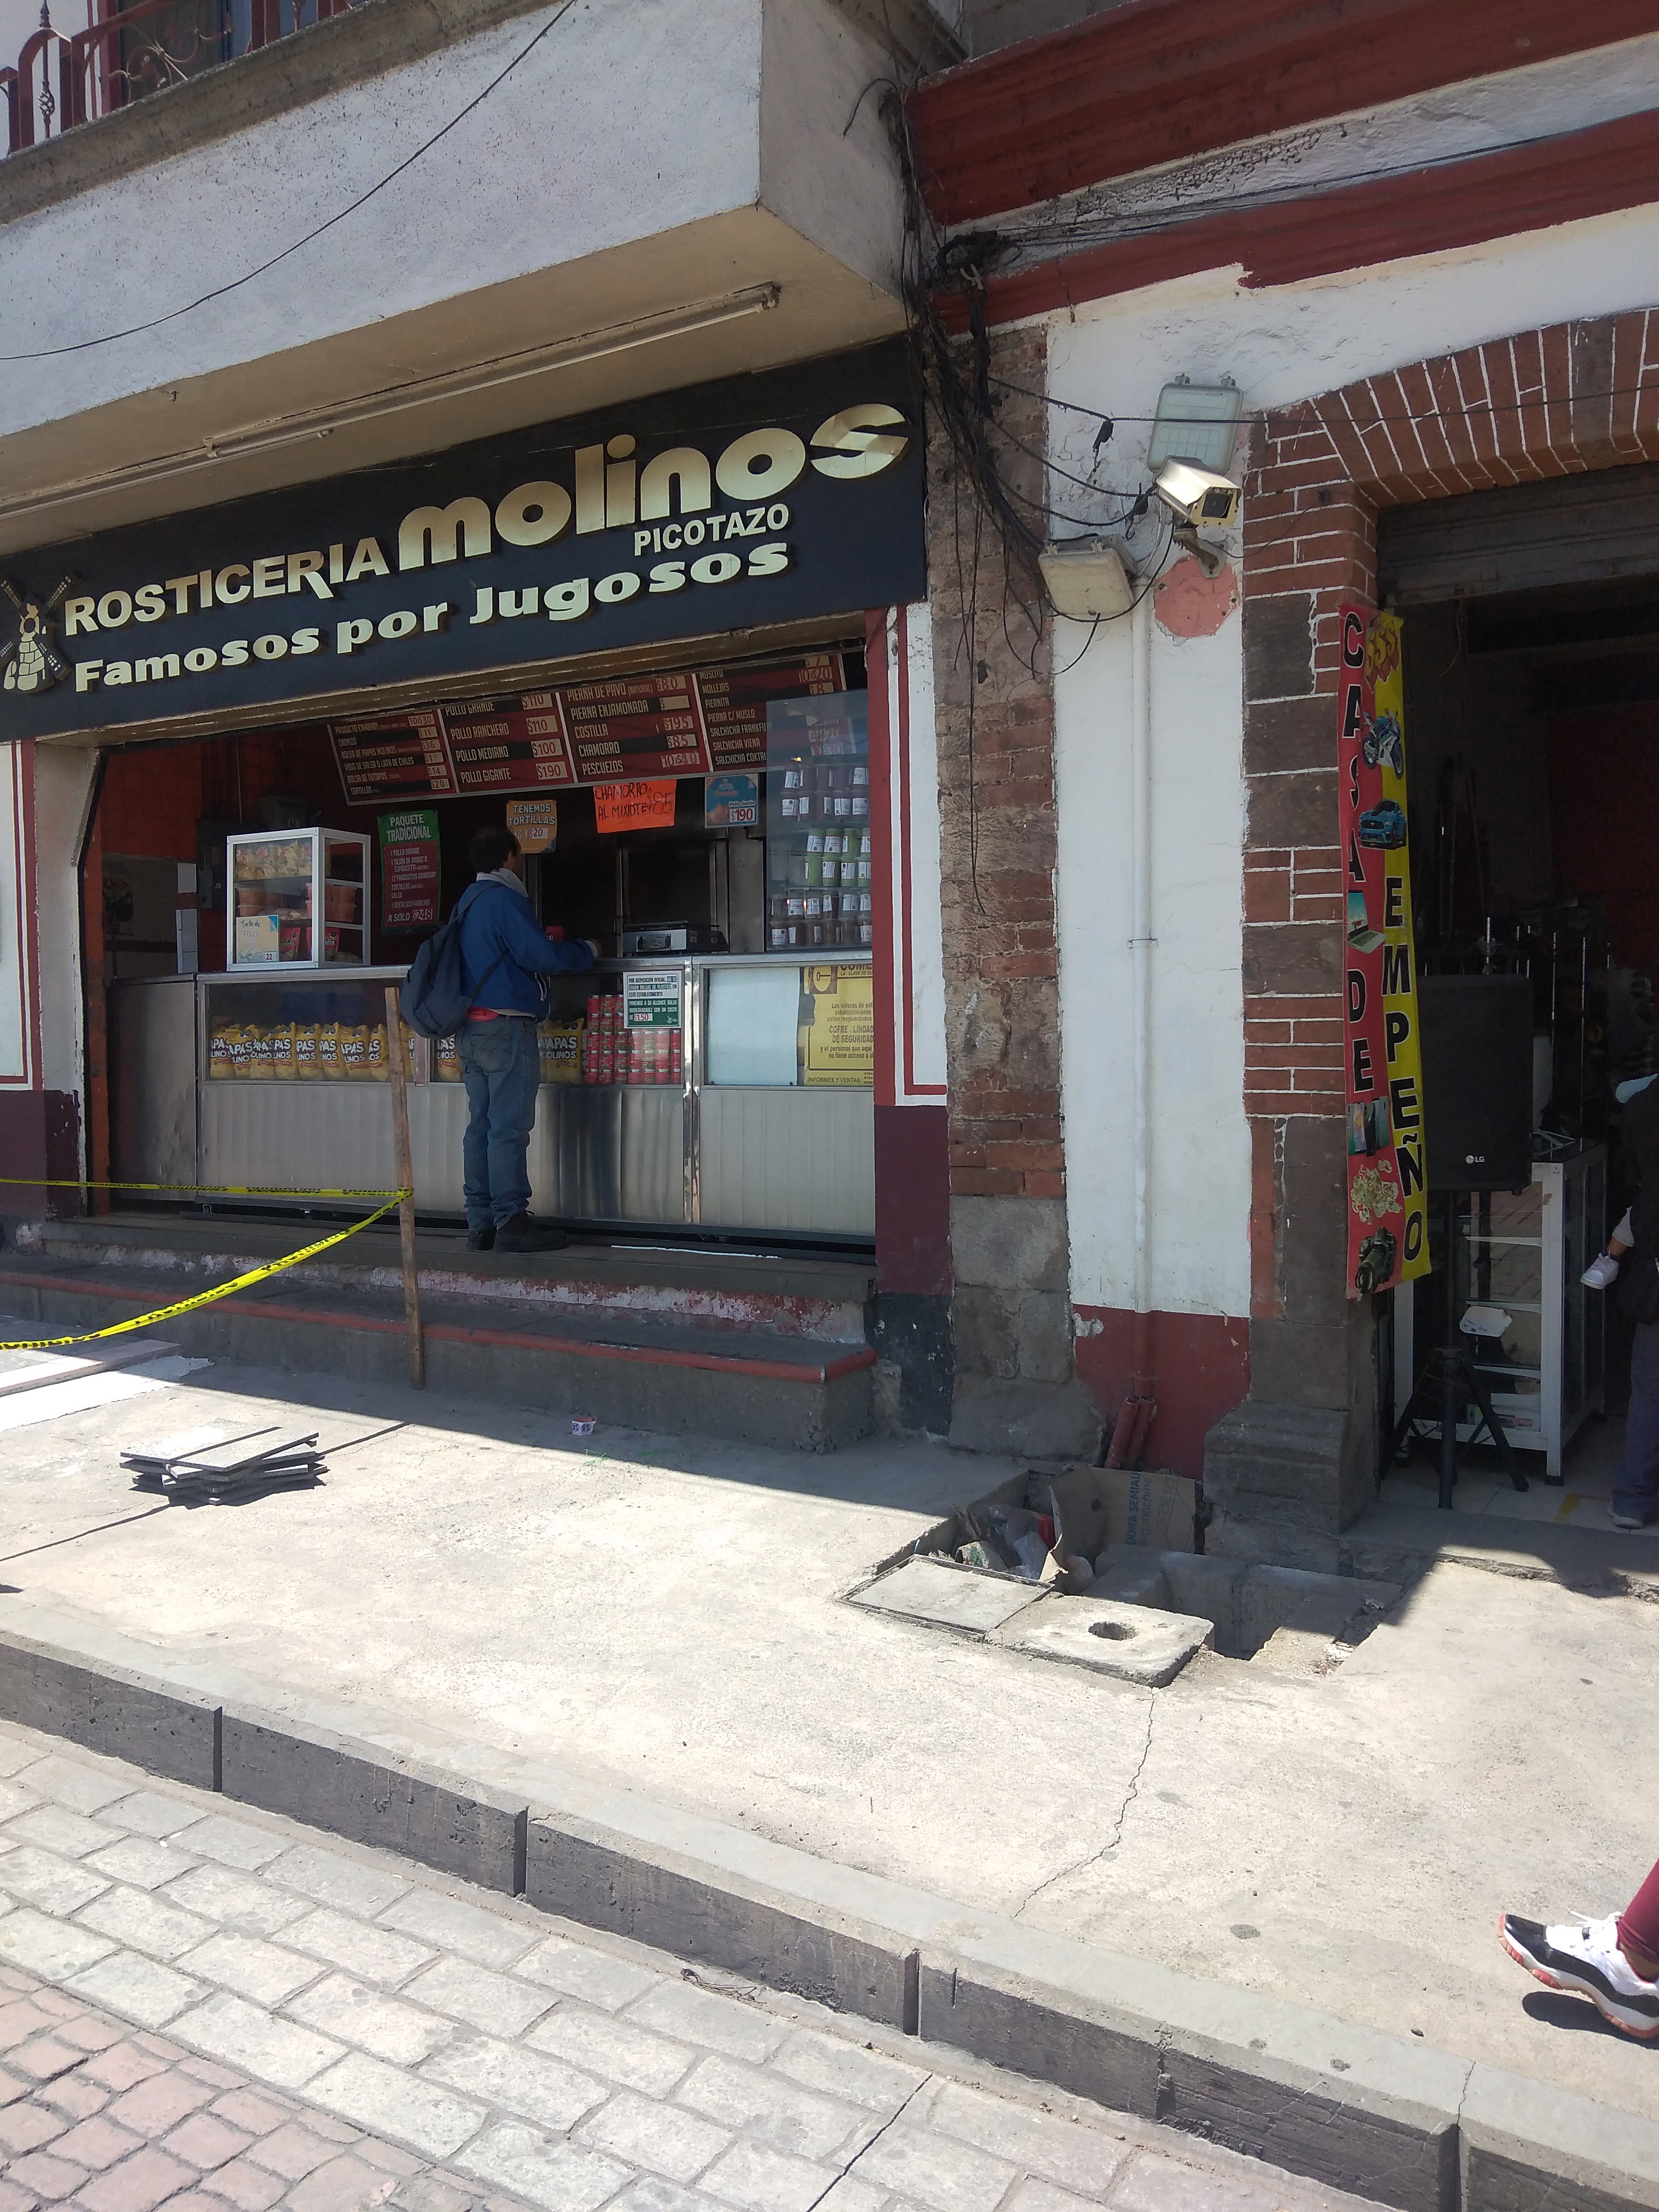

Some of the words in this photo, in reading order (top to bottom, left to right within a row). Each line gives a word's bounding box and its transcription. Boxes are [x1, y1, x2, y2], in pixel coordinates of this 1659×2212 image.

[634, 504, 789, 556] PICOTAZO
[65, 537, 389, 636] ROSTICERIA
[76, 627, 321, 693] Famosos
[337, 602, 448, 655] por
[470, 542, 789, 625] Jugosos
[567, 687, 594, 702] PIERNA
[596, 685, 605, 698] DE
[606, 683, 626, 697] PAVO
[702, 682, 730, 694] MOLLEJAS
[446, 703, 466, 716] POLLO
[468, 701, 495, 714] GRANDE
[571, 706, 597, 720] PIERNA
[598, 700, 649, 717] ENJAMONADA
[705, 697, 730, 708] PIERNITA
[707, 711, 727, 723] PIERNA
[736, 709, 756, 719] MUSLO
[450, 727, 472, 740] POLLO
[473, 723, 509, 738] RANCHERO
[527, 719, 547, 733] $110
[574, 723, 608, 739] COSTILLA
[710, 725, 741, 737] SALCHICHA
[455, 749, 477, 762] POLLO
[478, 745, 509, 759] MEDIANO
[532, 742, 556, 756] $100
[578, 741, 620, 758] CHAMORRO
[668, 735, 688, 748] $85
[713, 739, 743, 751] SALCHICHA
[743, 738, 760, 748] VIENA
[381, 758, 391, 767] LATA
[392, 757, 398, 766] DE
[399, 756, 414, 766] CHILES
[715, 753, 745, 765] SALCHICHA
[460, 770, 481, 784] POLLO
[483, 768, 512, 781] GIGANTE
[537, 764, 561, 778] $190
[582, 760, 624, 775] PESCUEZOS
[368, 772, 388, 781] TOTOPOS
[350, 785, 373, 795] TORTILLAS
[595, 782, 648, 801] CHAMORRO
[514, 803, 551, 814] TENEMOS
[598, 806, 609, 820] AL
[612, 802, 647, 818] MIXIOTE
[731, 808, 753, 822] $190
[390, 814, 424, 827] PAQUETE
[508, 815, 555, 826] TORTILLAS
[387, 825, 431, 842] TRADICIONAL
[240, 919, 253, 928] Torta
[254, 919, 261, 927] de
[388, 914, 392, 923] A
[1381, 876, 1423, 1262] EMPEÑO
[1142, 1477, 1152, 1525] machine
